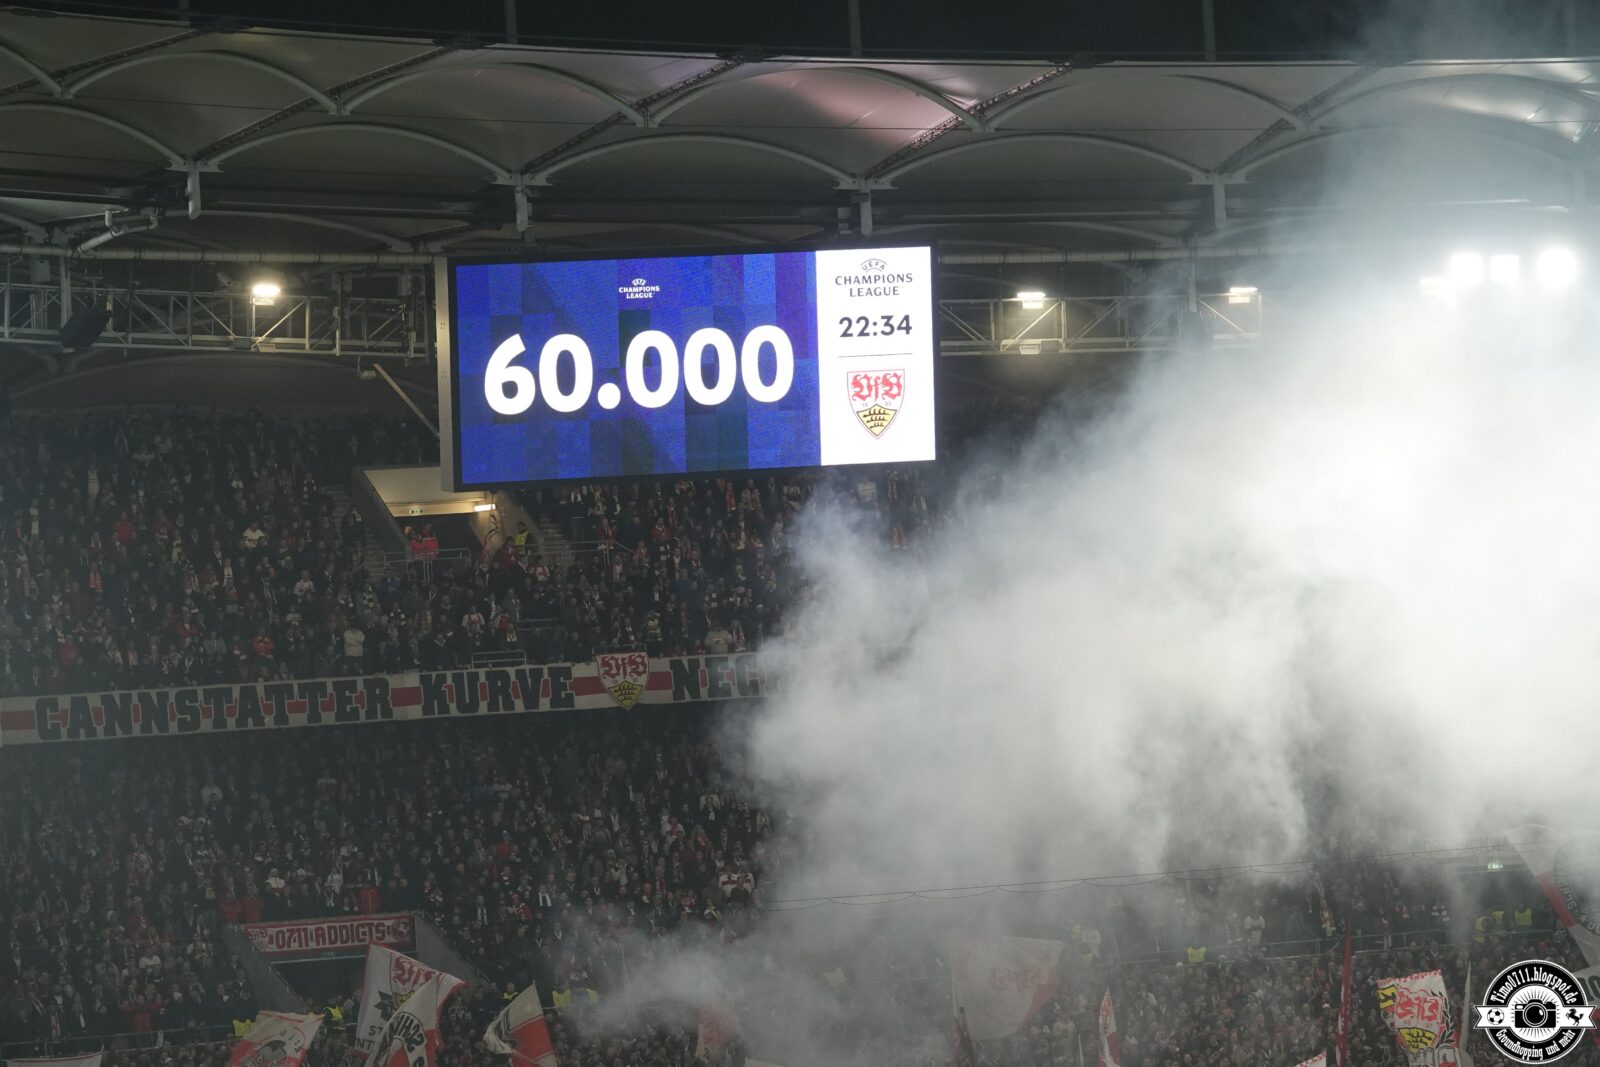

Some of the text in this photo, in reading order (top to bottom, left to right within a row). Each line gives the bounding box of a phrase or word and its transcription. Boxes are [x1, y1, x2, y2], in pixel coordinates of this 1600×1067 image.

[834, 272, 914, 286] CHAMPIONS
[618, 285, 660, 294] CHAMPIONS
[626, 292, 653, 300] LEAGUE
[849, 285, 901, 298] LEAGUE
[838, 314, 913, 338] 22:34
[484, 324, 795, 416] 60.000
[35, 677, 392, 741] CANNSTATTER
[420, 666, 576, 716] KURVE
[274, 927, 310, 950] 0711
[314, 922, 387, 947] ADDICTS
